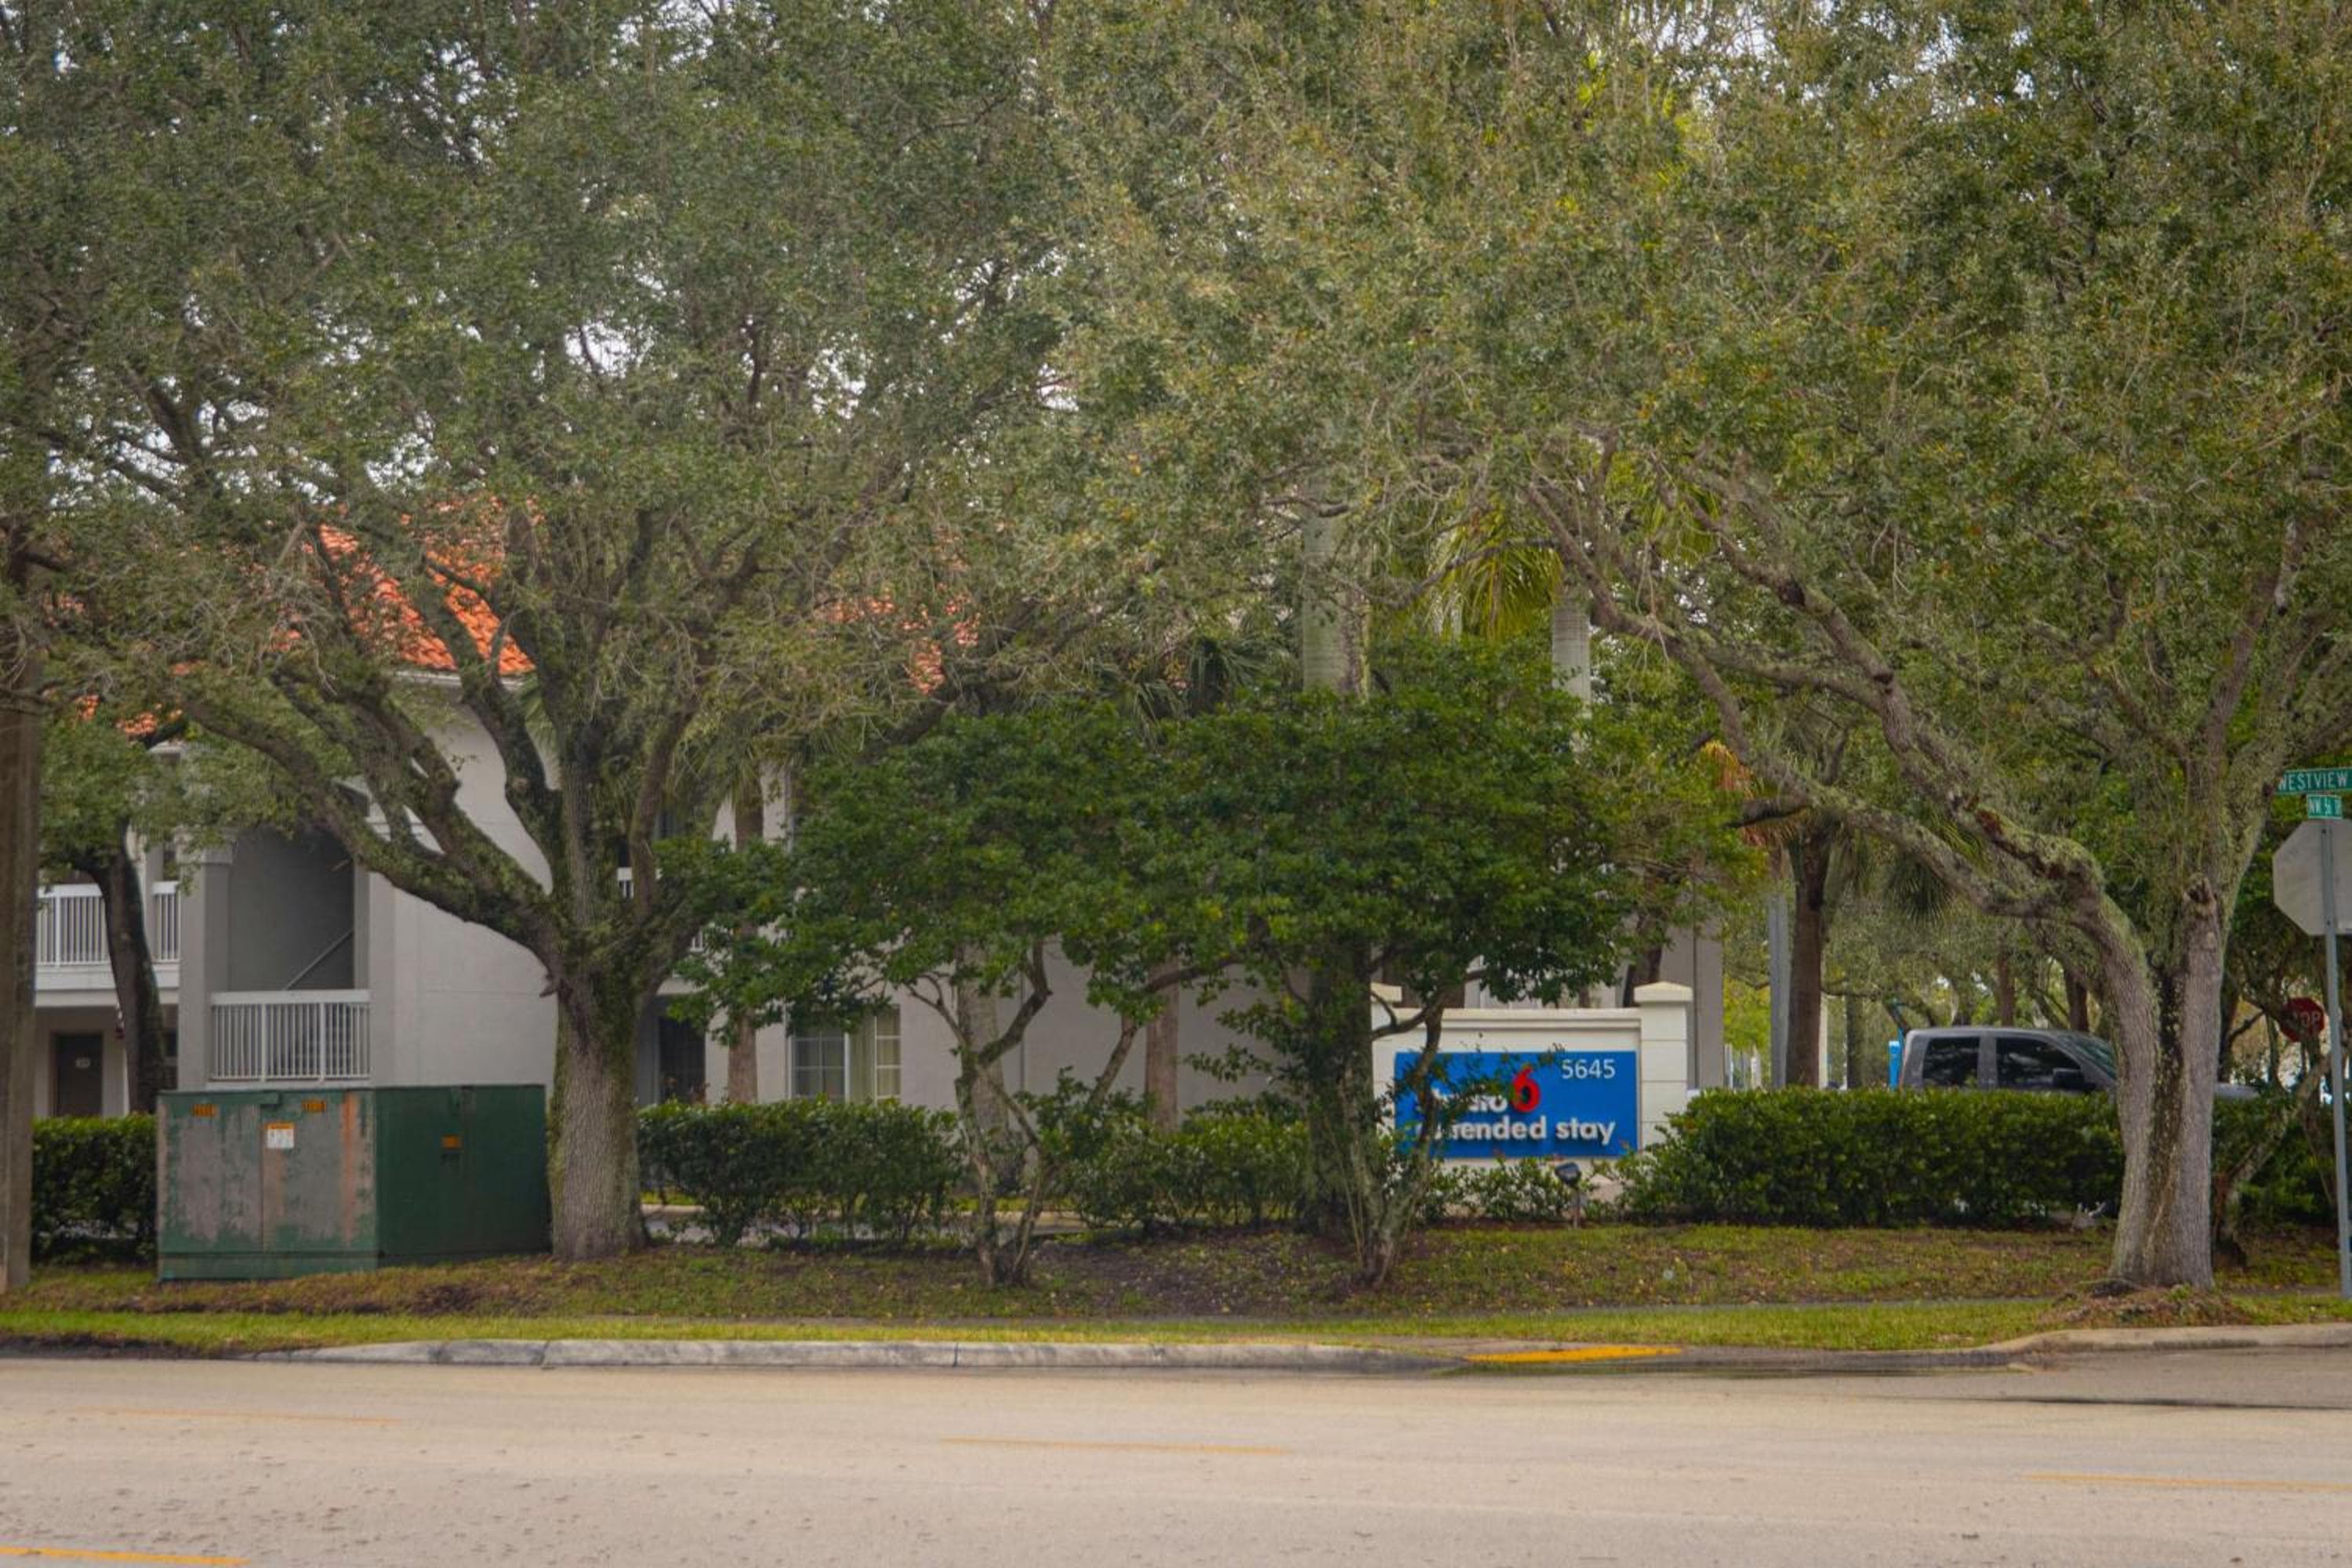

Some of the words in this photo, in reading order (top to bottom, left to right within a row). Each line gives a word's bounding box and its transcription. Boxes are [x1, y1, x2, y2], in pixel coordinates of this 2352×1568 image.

[2278, 771, 2348, 791] WESTVIEW
[1562, 1059, 1616, 1080] 5645
[1512, 1065, 1541, 1112] 6
[1414, 1115, 1547, 1140] tended
[1555, 1117, 1616, 1145] stay
